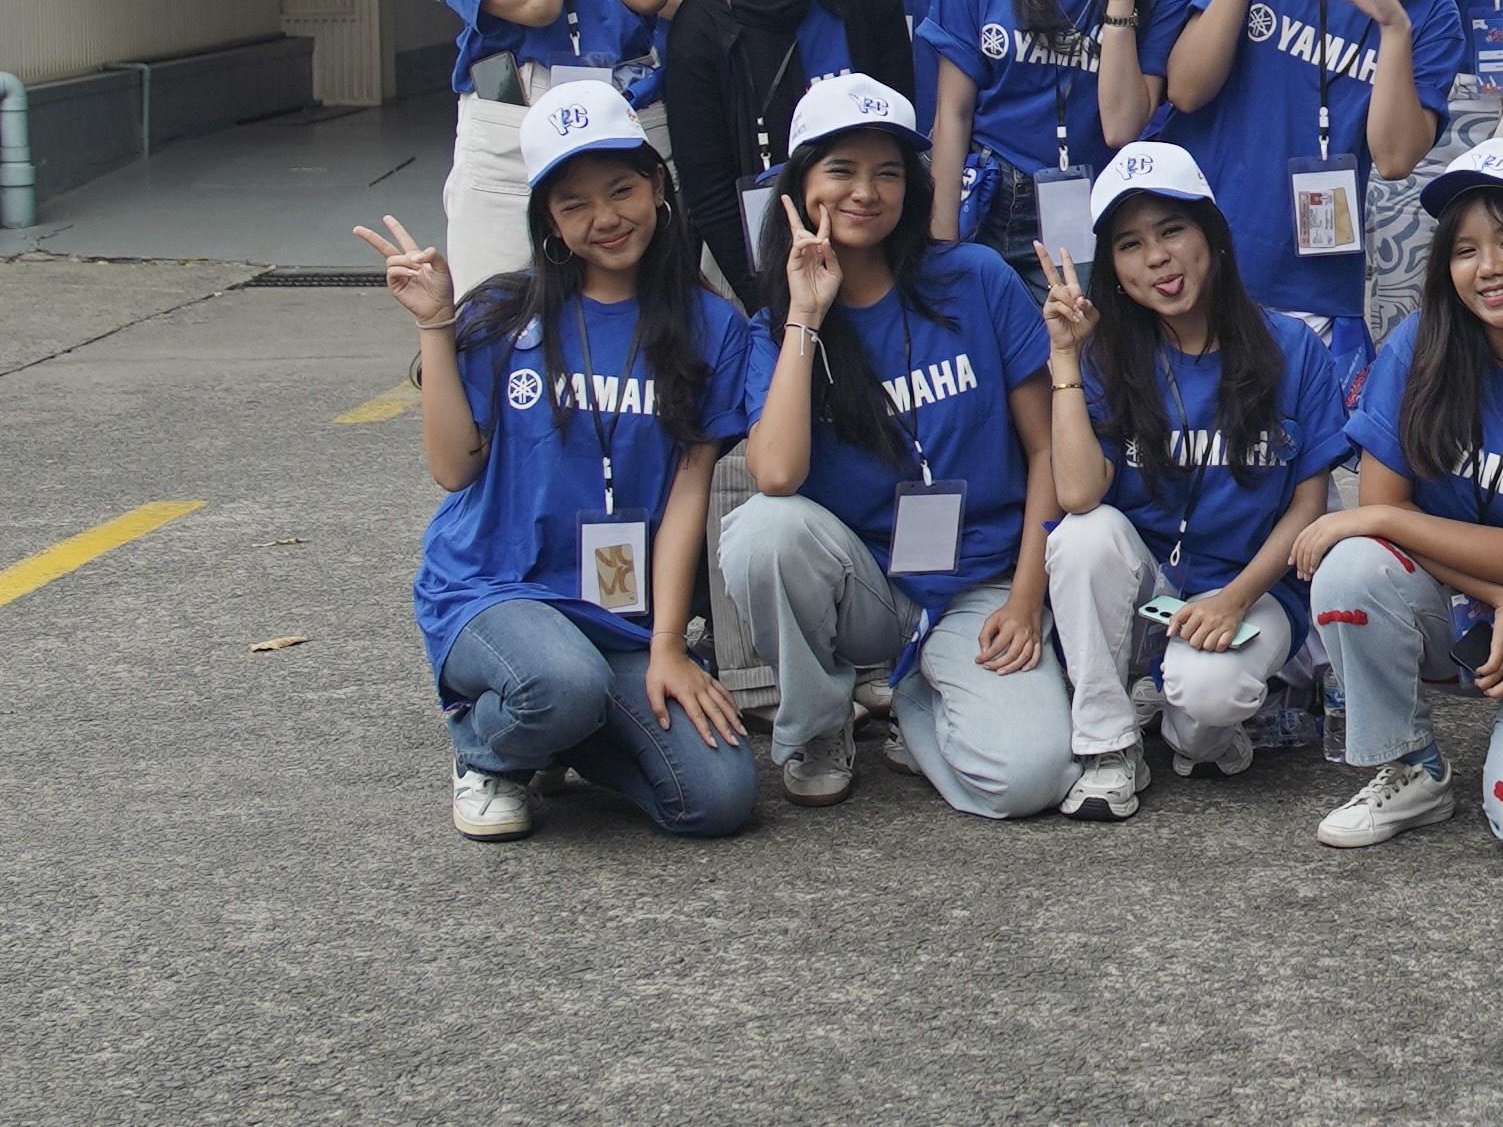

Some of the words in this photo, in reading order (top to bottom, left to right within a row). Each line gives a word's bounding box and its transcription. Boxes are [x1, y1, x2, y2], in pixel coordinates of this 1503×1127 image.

[1013, 24, 1104, 73] YAMA
[1277, 14, 1378, 85] YAMAH
[553, 372, 661, 416] YAMAH
[882, 353, 978, 416] MAHA
